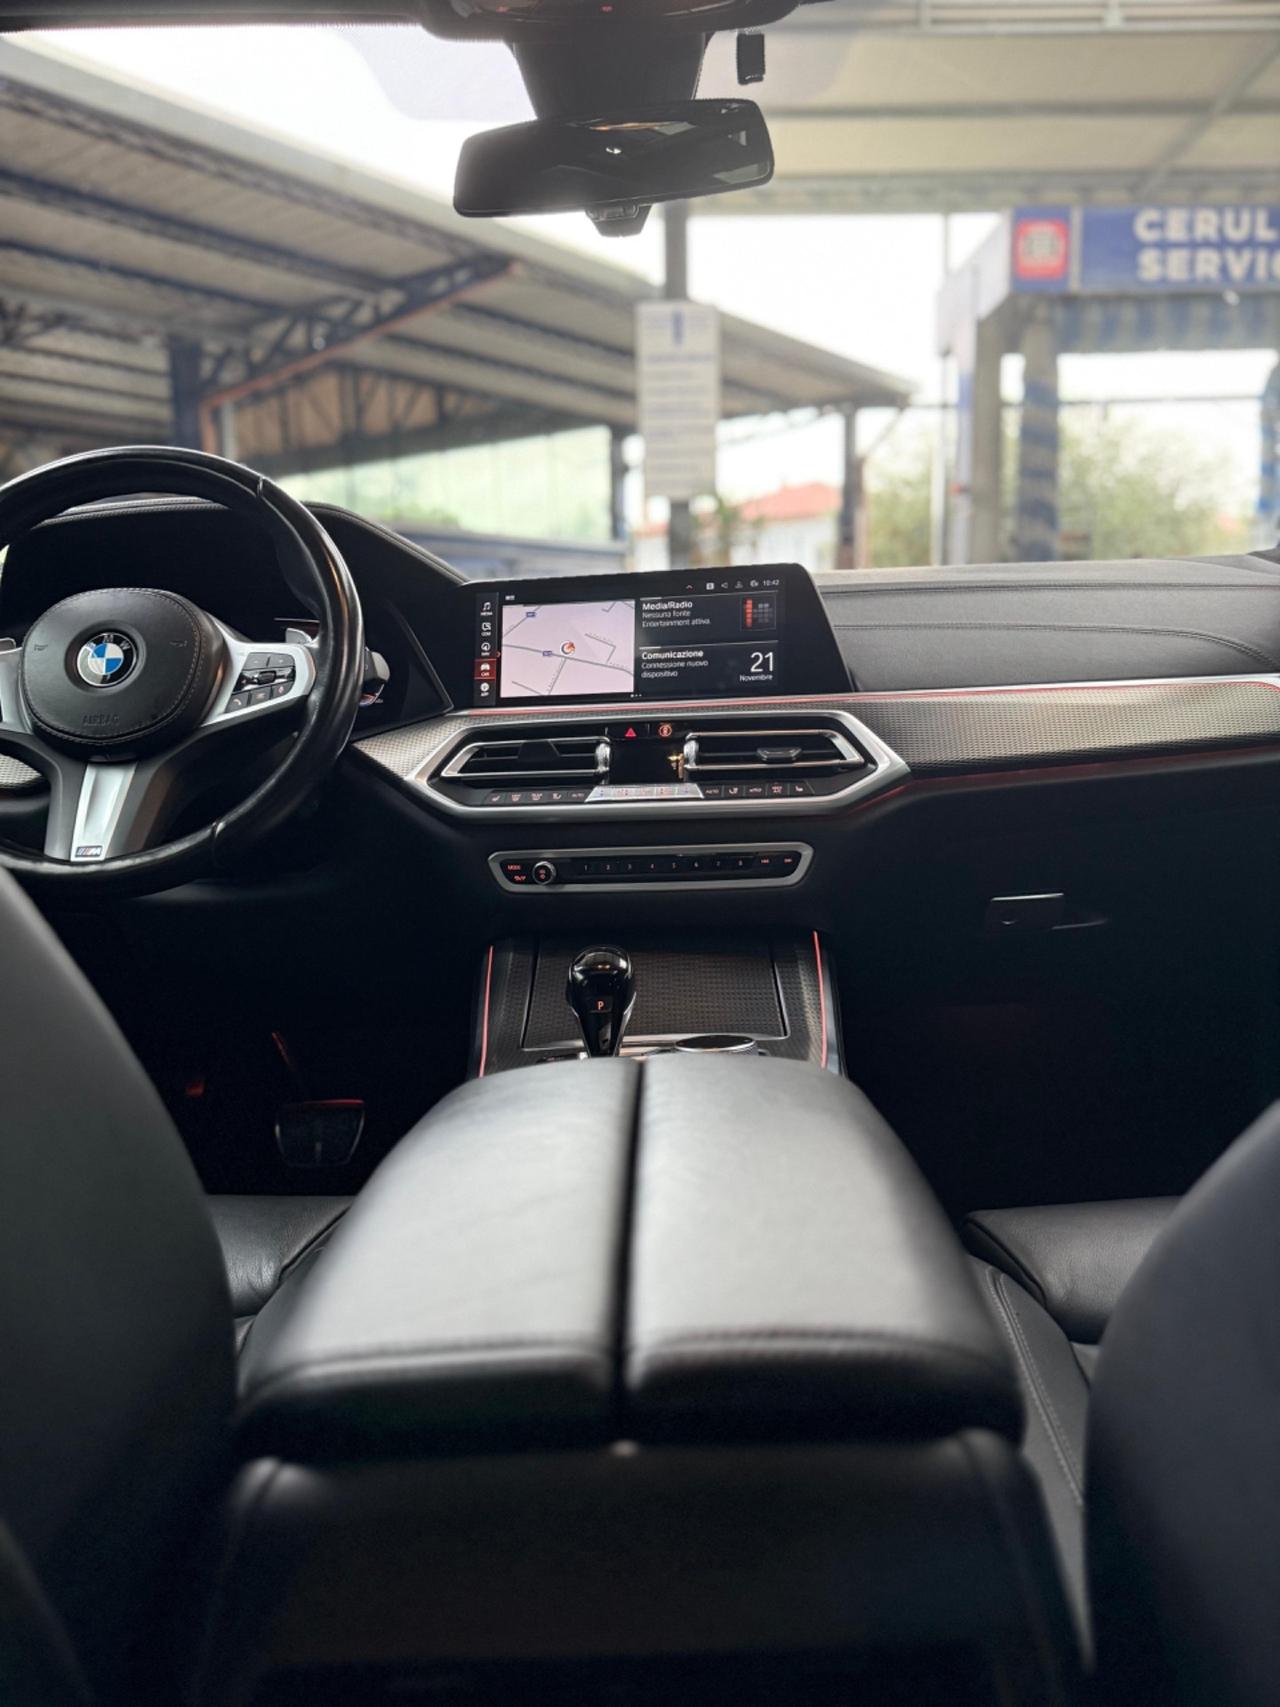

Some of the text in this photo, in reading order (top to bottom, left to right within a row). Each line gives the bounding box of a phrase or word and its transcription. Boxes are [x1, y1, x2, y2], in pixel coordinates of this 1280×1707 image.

[1134, 208, 1277, 242] CERUL
[763, 579, 780, 587] 10:42
[642, 600, 693, 611] Media/Radio
[642, 611, 671, 619] Nessuna
[641, 650, 704, 661] Comunicazione
[750, 651, 774, 673] 21
[641, 670, 678, 679] dispositivo
[739, 674, 773, 682] Novembre
[598, 1000, 605, 1010] P
